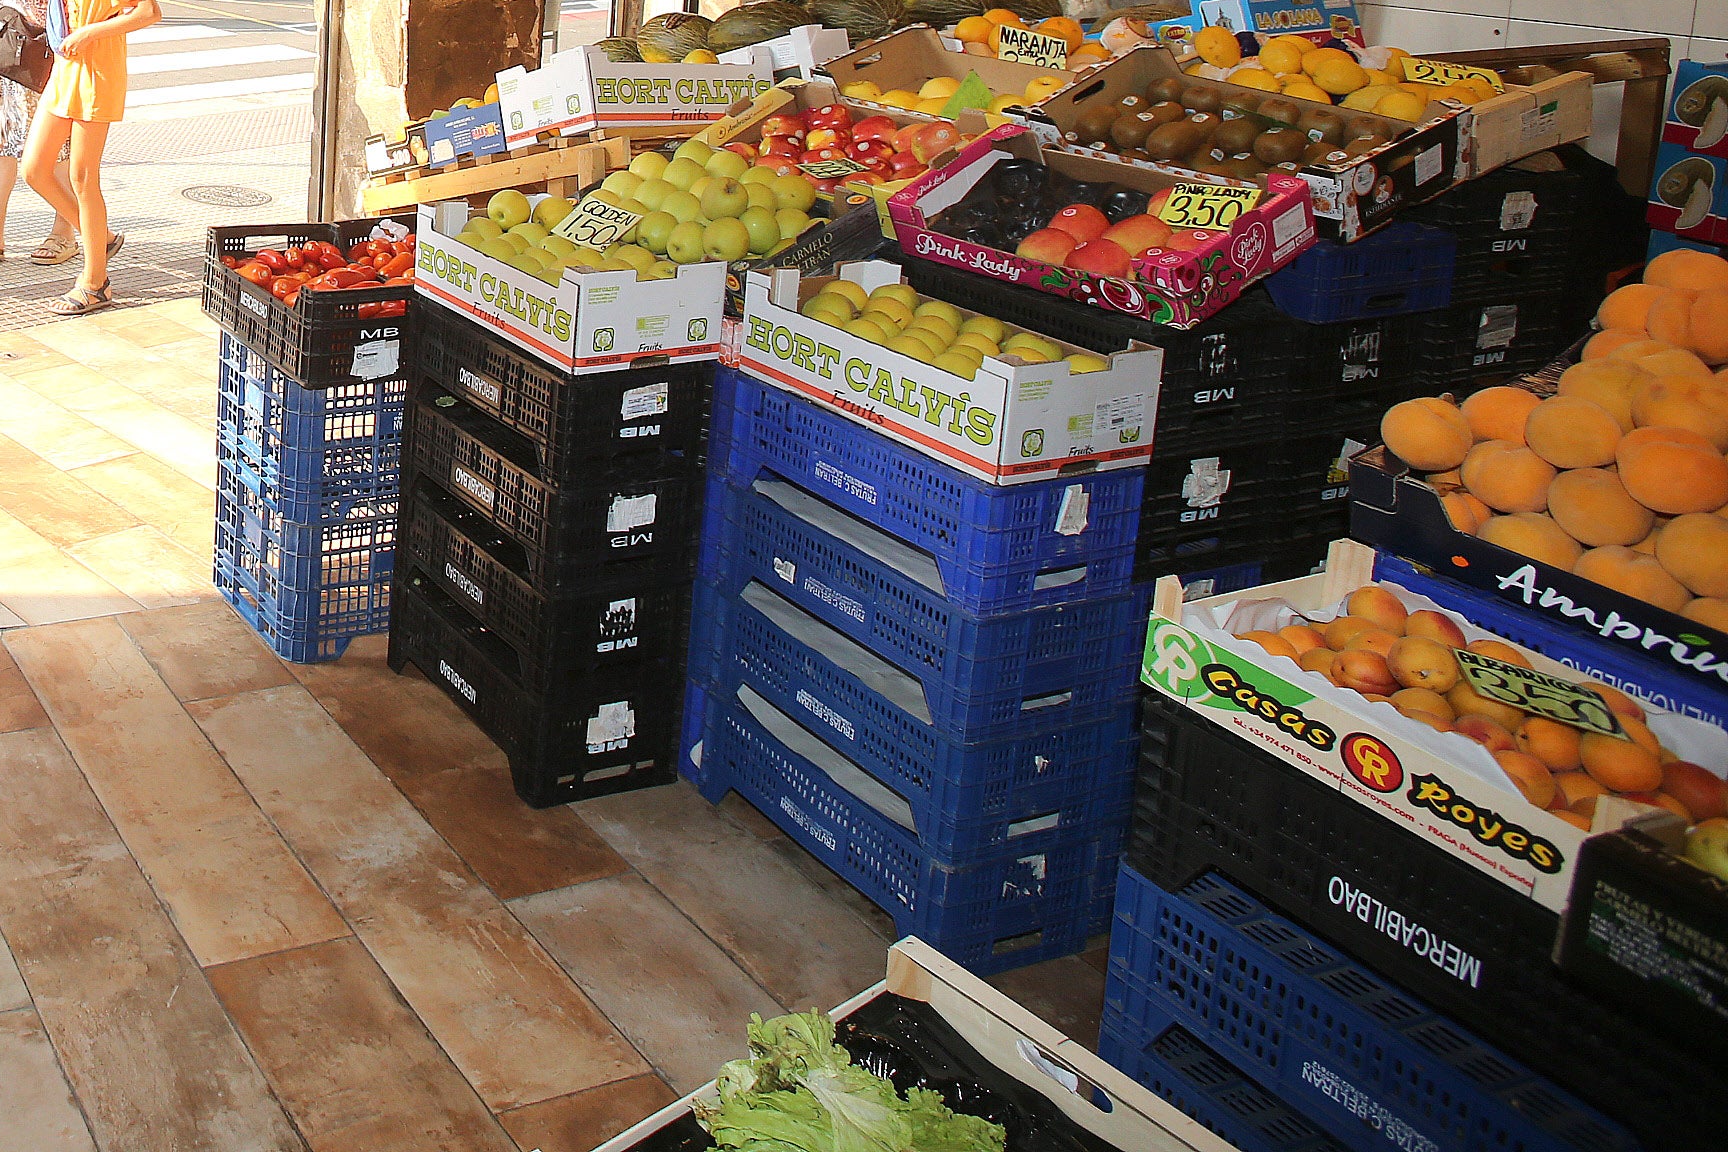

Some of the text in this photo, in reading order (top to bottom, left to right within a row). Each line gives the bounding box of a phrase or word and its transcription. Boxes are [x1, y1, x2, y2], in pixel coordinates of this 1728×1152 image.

[1256, 8, 1324, 30] LA SOLANA
[596, 74, 771, 105] HORT CALVÍS
[671, 108, 710, 121] Fruits
[582, 199, 636, 226] GOLDEN
[782, 232, 833, 266] CARMELO
[915, 233, 1024, 281] Pink Lady
[1237, 227, 1259, 259] Pink
[1242, 235, 1264, 266] Lady
[1492, 239, 1526, 252] MB
[418, 241, 573, 343] HORT CALVÍS
[470, 301, 507, 331] Fruits
[360, 327, 400, 340] MB
[637, 341, 663, 353] Fruits
[1473, 351, 1505, 366] MB
[745, 314, 997, 446] HORT CALVÍS
[1193, 386, 1235, 404] MB
[833, 389, 885, 425] Fruits
[619, 424, 661, 438] MB
[1068, 445, 1095, 457] Fruits
[850, 484, 877, 506] FRUTAS
[1180, 506, 1219, 523] MB
[611, 532, 653, 548] MB
[597, 636, 638, 653] MB
[1151, 624, 1198, 692] CR
[1206, 669, 1331, 746] Casas
[587, 738, 629, 754] MB
[1352, 737, 1391, 788] CR
[1249, 726, 1264, 739] +34
[1264, 733, 1280, 747] 974
[1280, 743, 1295, 756] 471
[1296, 752, 1312, 766] 850
[1428, 824, 1458, 847] FRAGA
[1415, 781, 1555, 868] Royes
[1328, 876, 1483, 989] MERCABILBAO
[1301, 1066, 1368, 1120] BELTRAN
